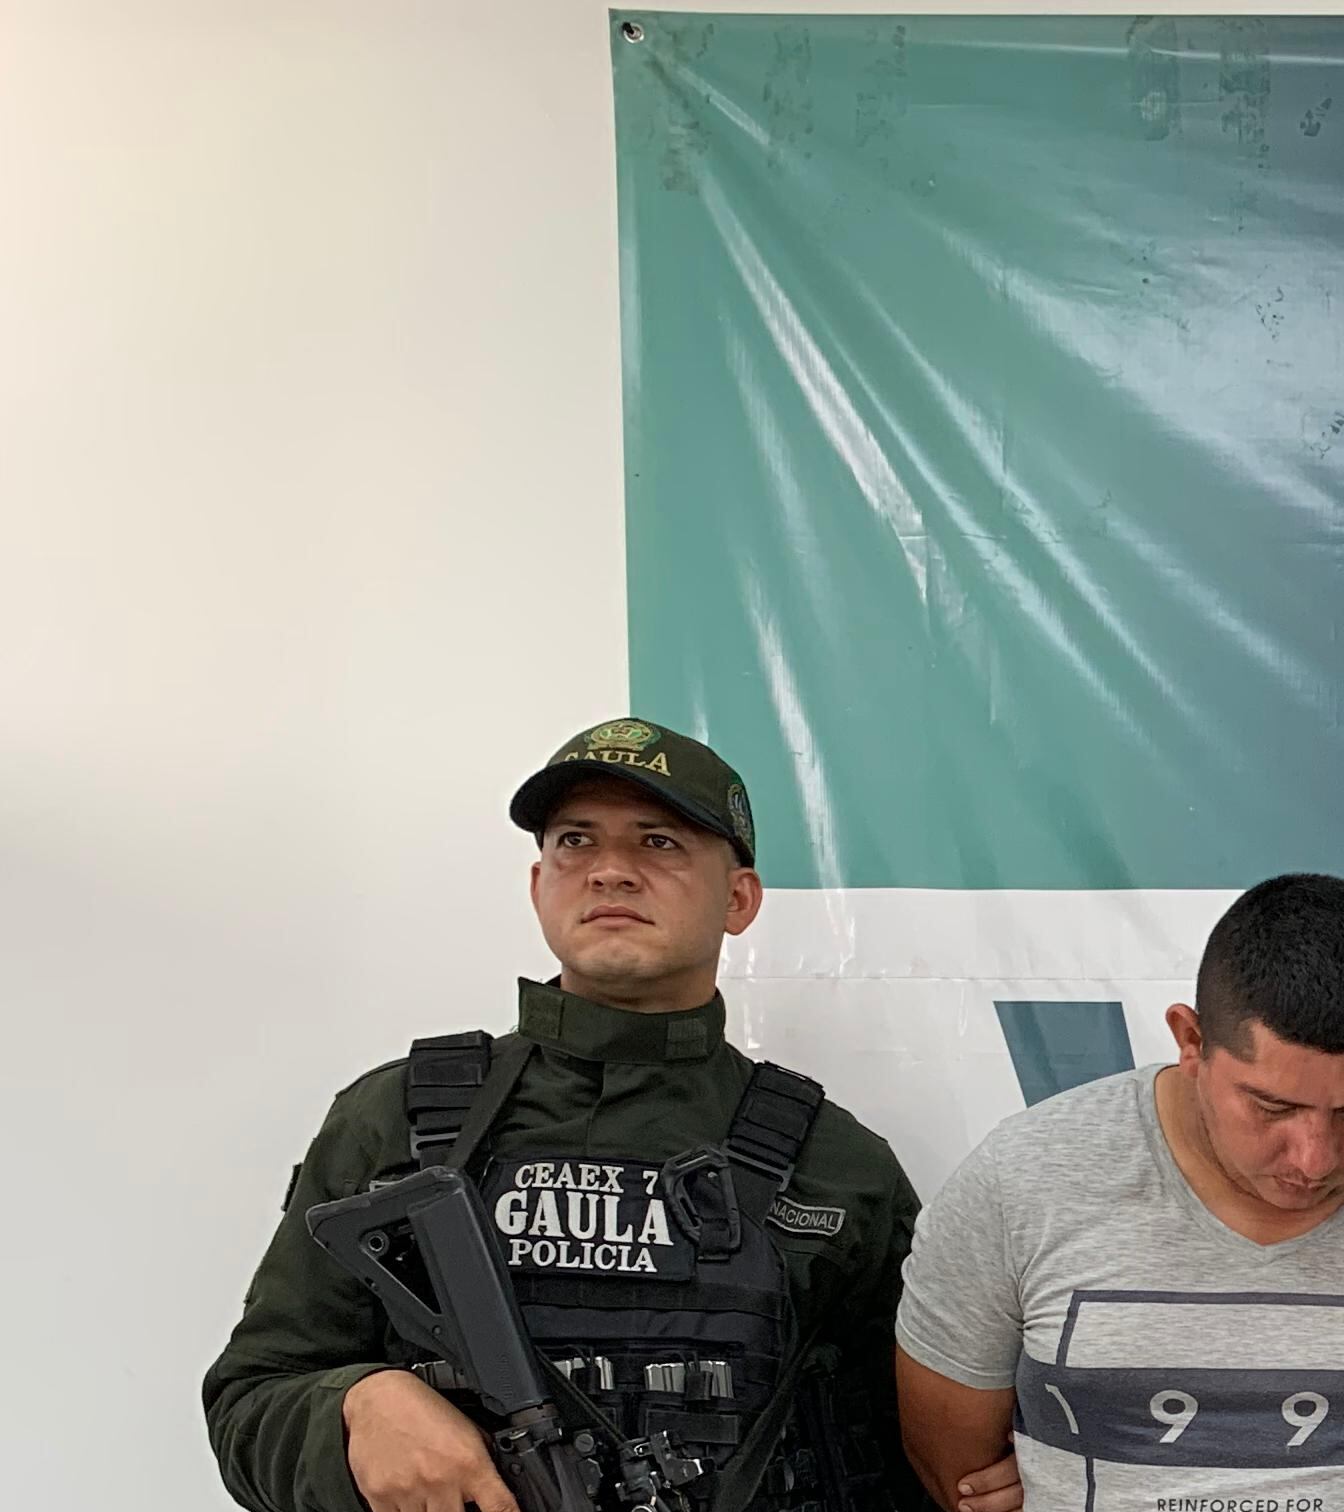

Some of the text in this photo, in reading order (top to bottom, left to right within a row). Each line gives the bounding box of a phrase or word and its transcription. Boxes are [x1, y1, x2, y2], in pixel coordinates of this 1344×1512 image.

[515, 1162, 659, 1195] CEAEX 7
[495, 1189, 674, 1246] GAULA
[769, 1200, 836, 1230] NACIONAL
[508, 1238, 658, 1273] POLICIA
